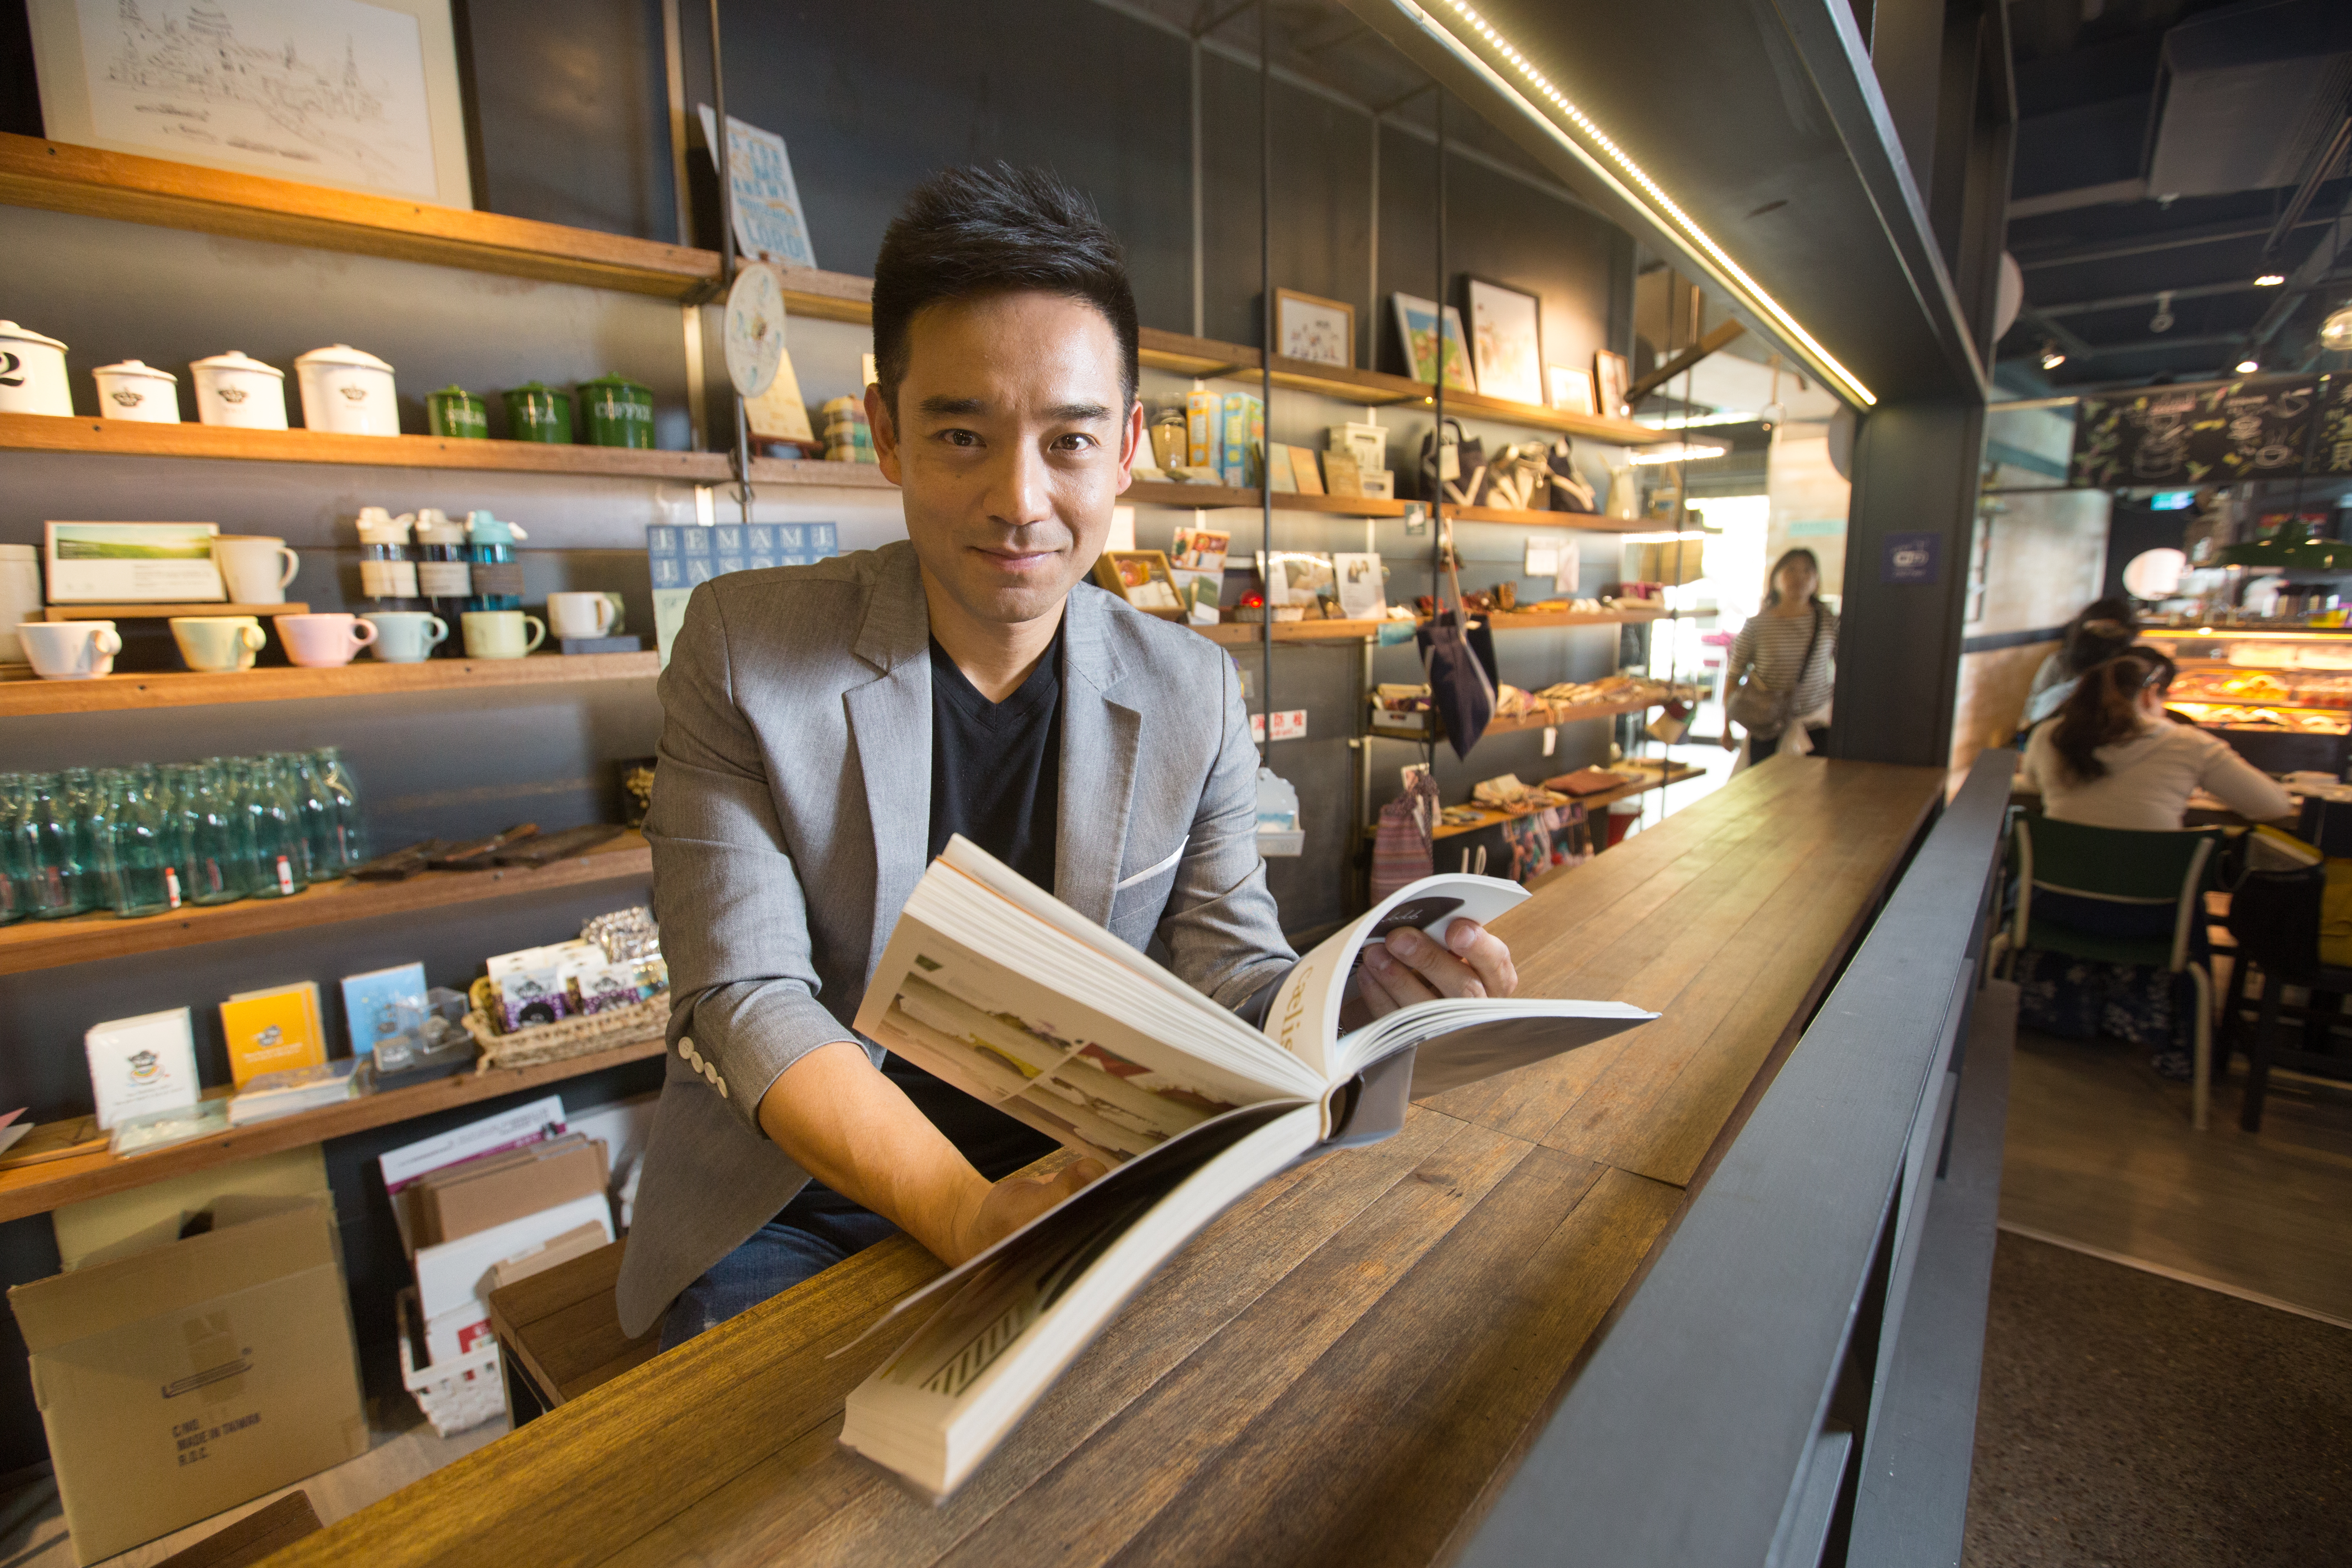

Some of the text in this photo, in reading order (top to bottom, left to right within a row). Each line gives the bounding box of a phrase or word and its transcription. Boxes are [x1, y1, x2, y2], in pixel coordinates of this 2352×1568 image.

[0, 352, 24, 387] 2
[520, 406, 558, 424] TEA
[177, 1431, 207, 1451] MADE
[209, 1427, 222, 1440] IN
